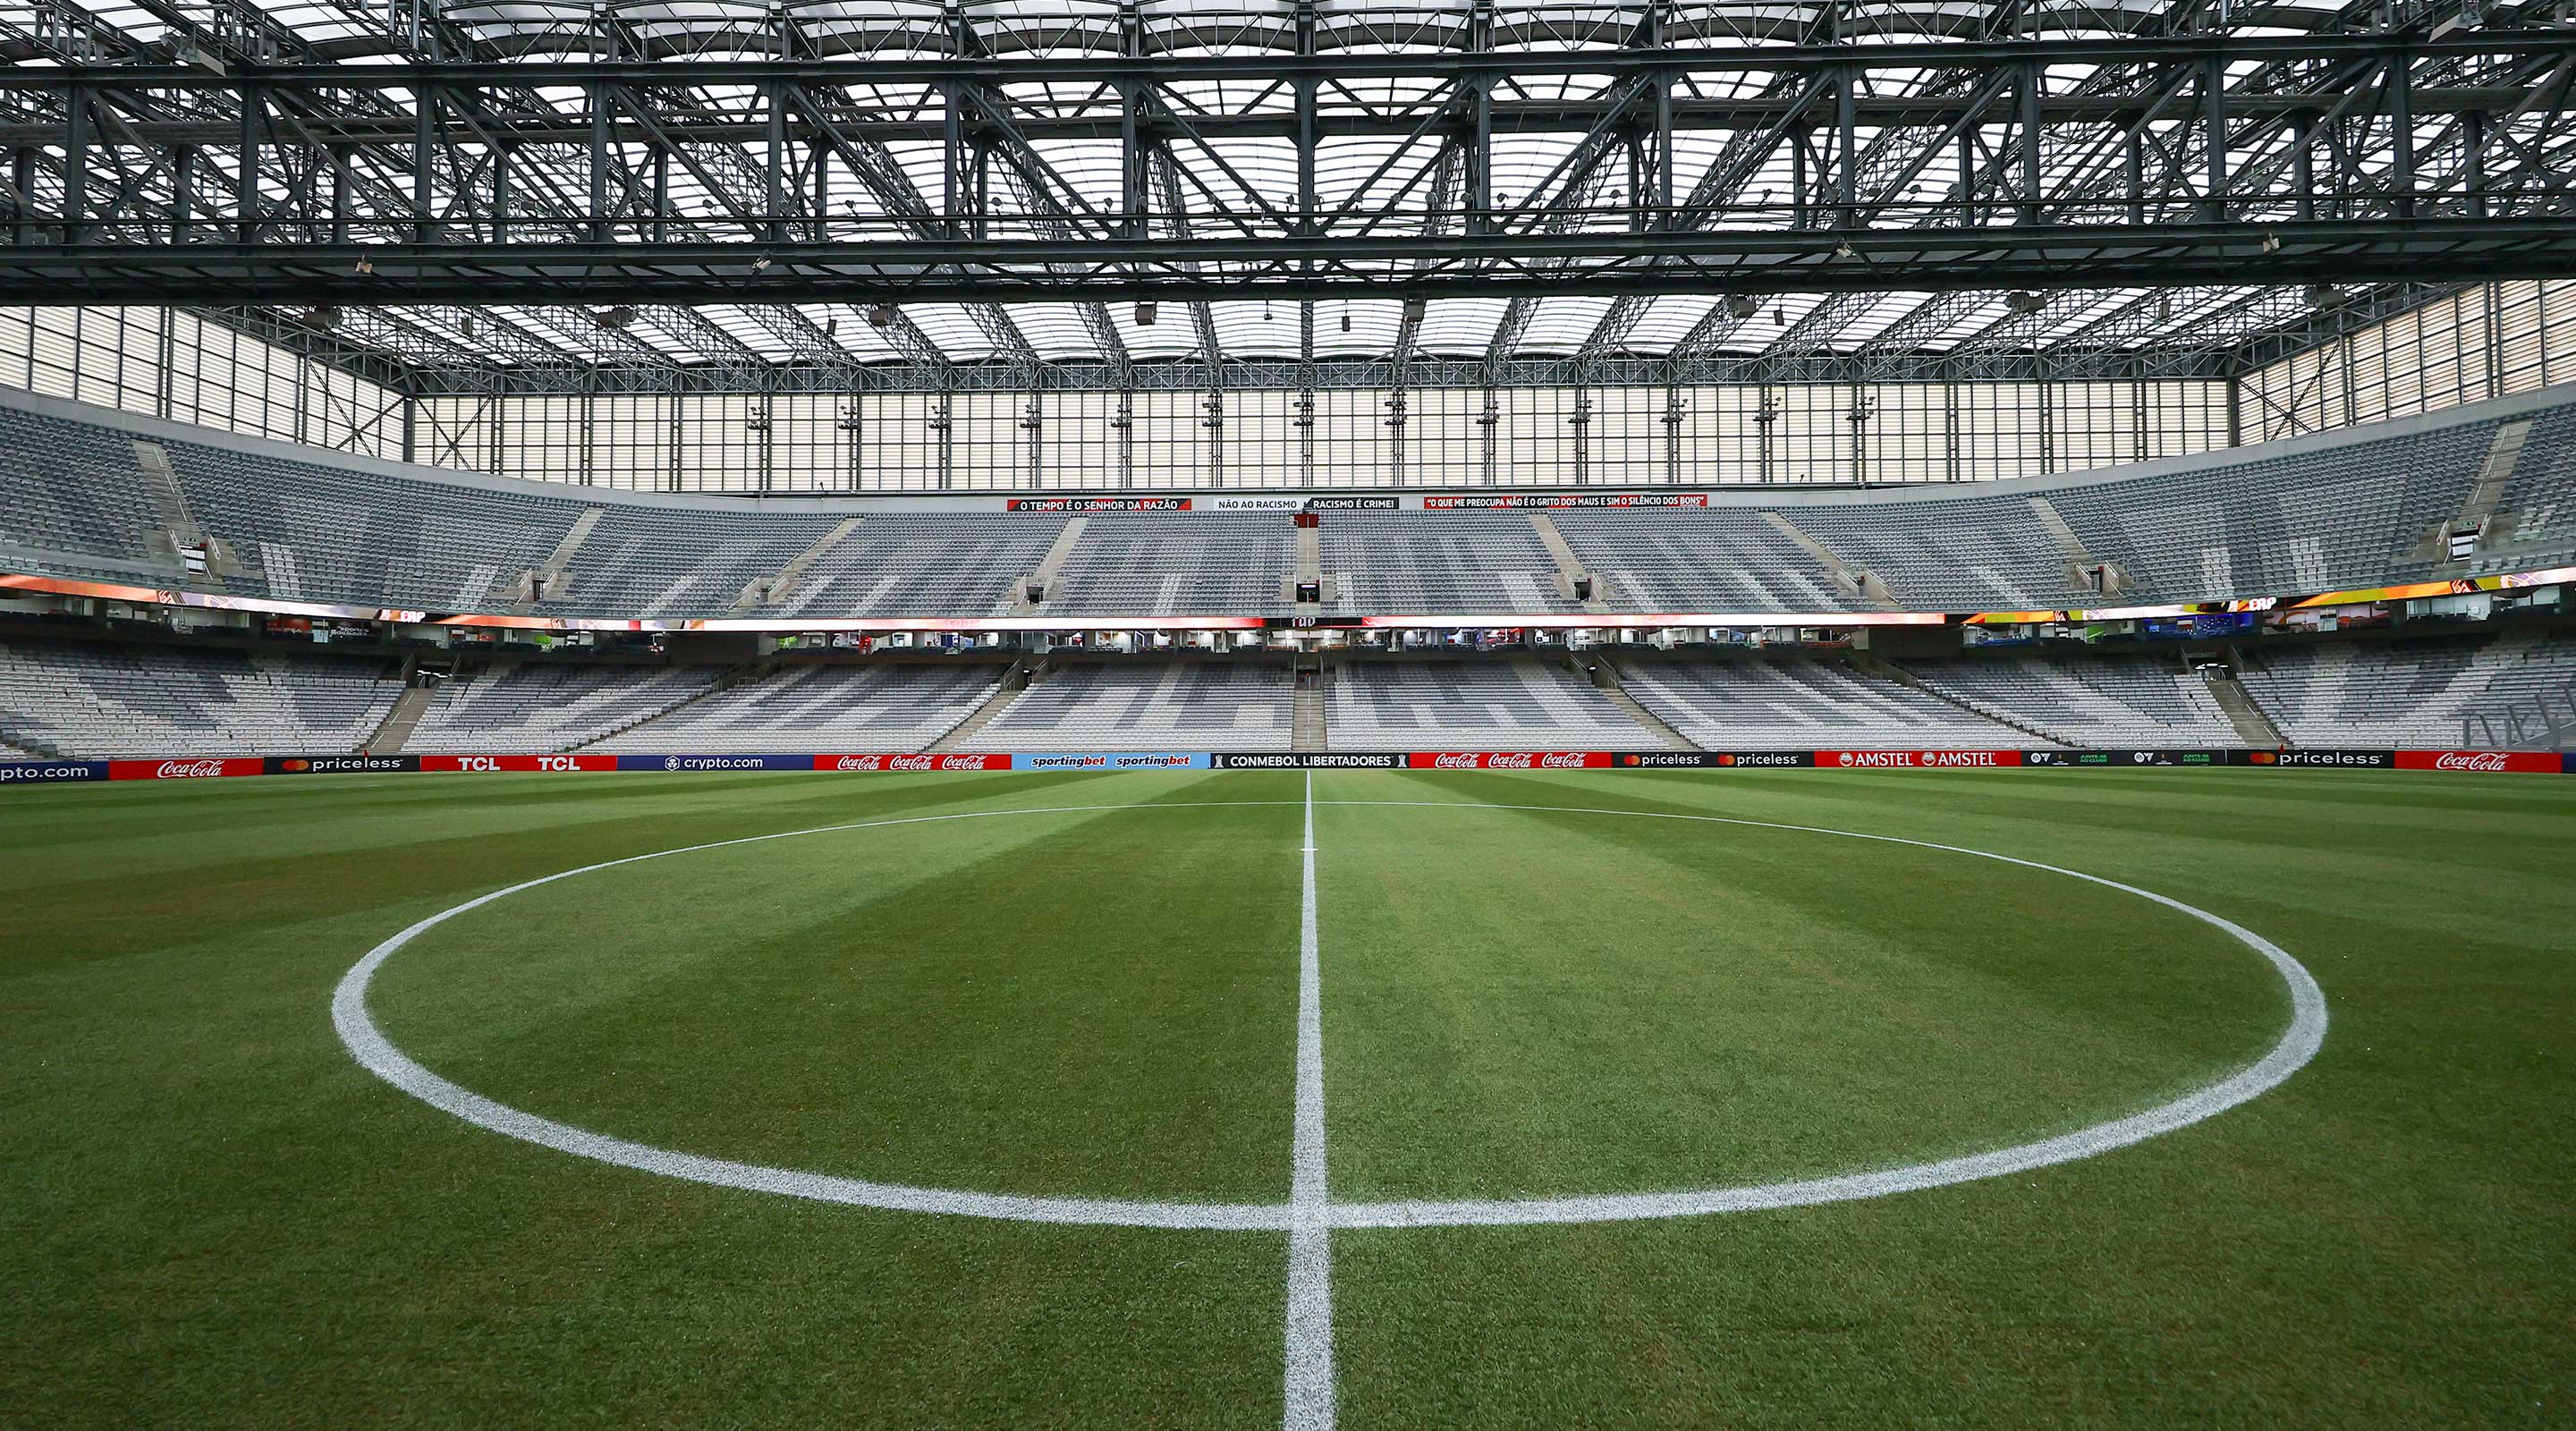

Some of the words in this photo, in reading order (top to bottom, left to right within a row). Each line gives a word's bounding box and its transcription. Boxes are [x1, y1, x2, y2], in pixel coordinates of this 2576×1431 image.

[1020, 502, 1028, 511] O
[1030, 502, 1064, 511] TEMPO
[1066, 500, 1072, 510] É
[1074, 502, 1082, 510] O
[1084, 501, 1125, 510] SENHOR
[1127, 501, 1141, 510] DA
[1143, 499, 1178, 510] RAZÃO
[1218, 499, 1239, 509] NÃO
[1241, 501, 1254, 509] AO
[1256, 501, 1297, 509] RACISMO
[1313, 500, 1354, 509] RACISMO
[1356, 498, 1361, 508] É
[1364, 500, 1394, 508] CRIME!
[1437, 499, 1453, 507] QUE
[1454, 499, 1465, 507] ME
[1466, 498, 1505, 507] PREOCUPA
[1506, 497, 1522, 506] NÃO
[1523, 497, 1529, 506] É
[1530, 498, 1536, 506] O
[1537, 498, 1560, 506] GRITO
[1561, 498, 1576, 506] DOS
[1577, 497, 1599, 506] MAUS
[1600, 497, 1606, 505] E
[1606, 496, 1620, 505] SIM
[1621, 497, 1627, 505] O
[1628, 495, 1662, 505] SILÊNCIO
[1663, 496, 1678, 504] DOS
[313, 757, 402, 772] priceless
[458, 758, 501, 771] TCL
[538, 758, 580, 771] TCL
[683, 758, 763, 770] crypto.com
[837, 756, 883, 770] Coca-Cola
[889, 756, 935, 770] Coca-Cola
[942, 755, 987, 770] Coca-Cola
[1031, 756, 1106, 767] sportingbet
[1116, 755, 1191, 767] sportingbet
[1230, 756, 1300, 766] CONMEBOL
[1302, 756, 1392, 766] LIBERTADORES
[1435, 753, 1480, 768] Coca-Cola
[1487, 753, 1533, 768] Coca-Cola
[1541, 752, 1587, 767] Coca-Cola
[1642, 754, 1700, 766] priceless
[1737, 753, 1797, 766] priceless
[1855, 752, 1914, 766] AMSTEL
[1937, 752, 1996, 766] AMSTEL
[2279, 752, 2381, 766] priceless
[2436, 752, 2511, 771] Coca-Cola
[157, 760, 225, 778] Coca-Cola
